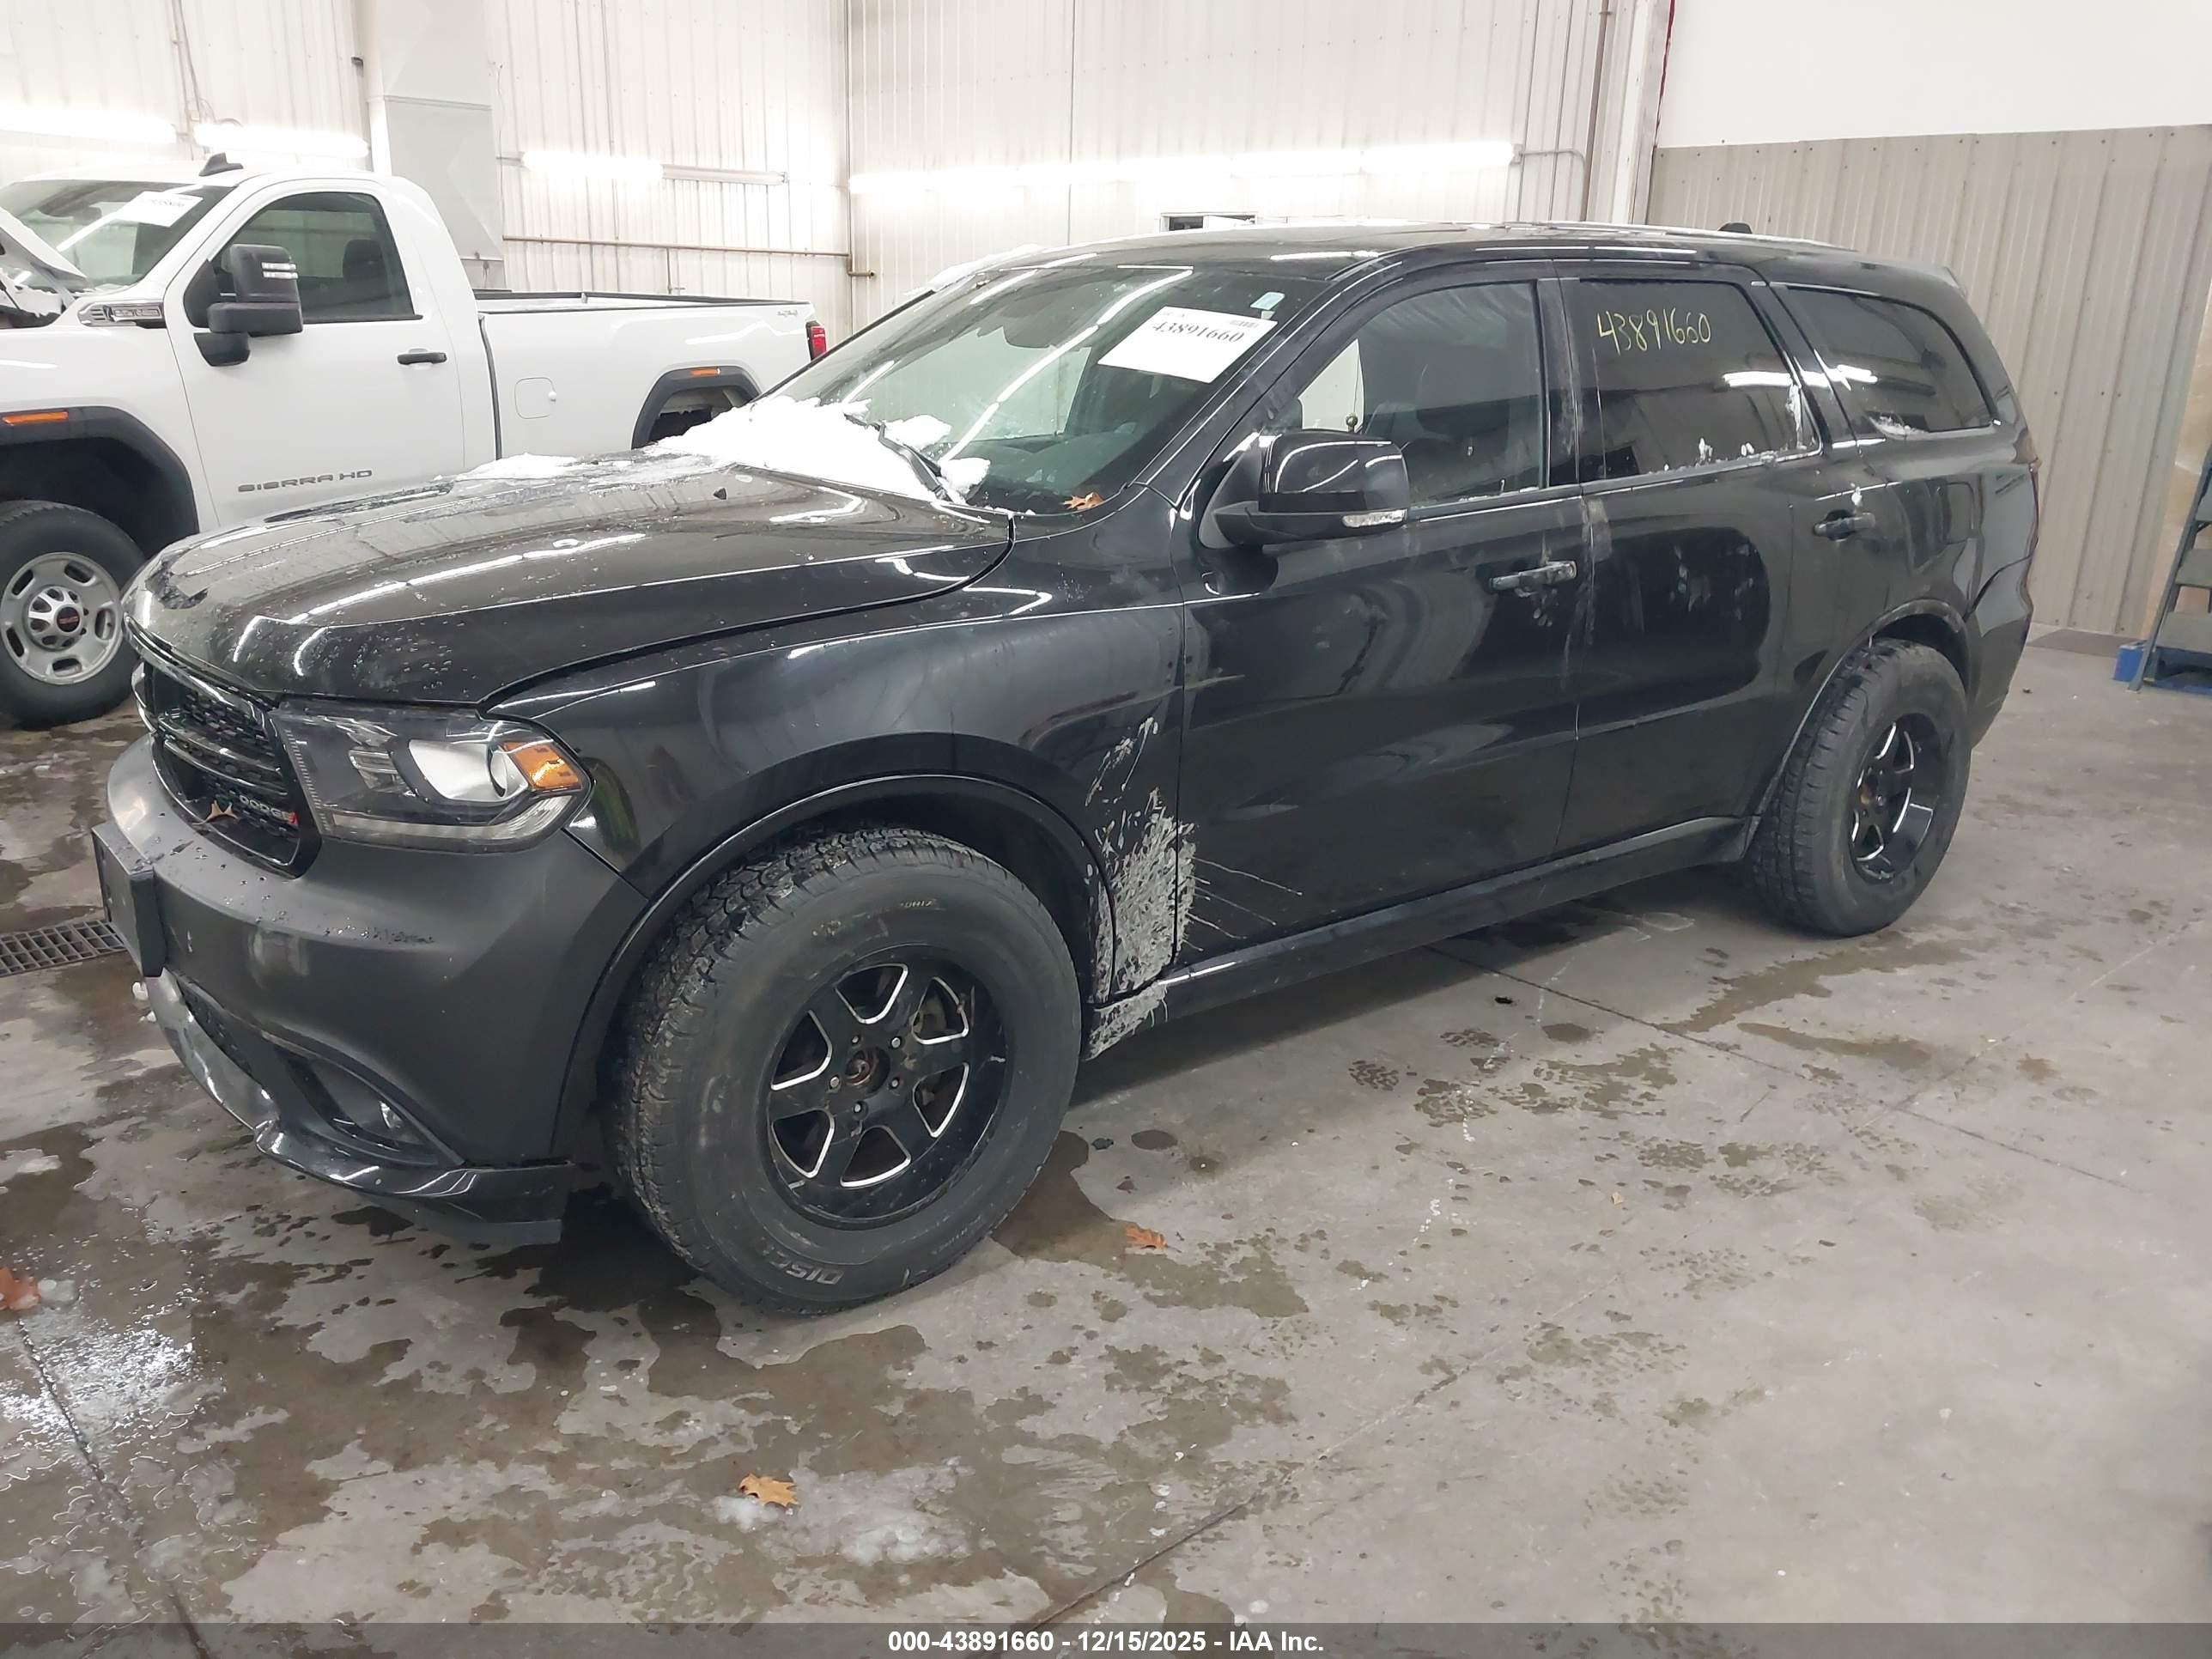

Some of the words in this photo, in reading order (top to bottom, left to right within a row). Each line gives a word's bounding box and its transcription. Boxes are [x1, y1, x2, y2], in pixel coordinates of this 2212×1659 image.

[1152, 321, 1245, 343] 43891660
[1597, 307, 1711, 356] 43891660
[238, 474, 333, 492] SIERRA
[339, 470, 373, 481] HD
[239, 794, 290, 822] DODGE
